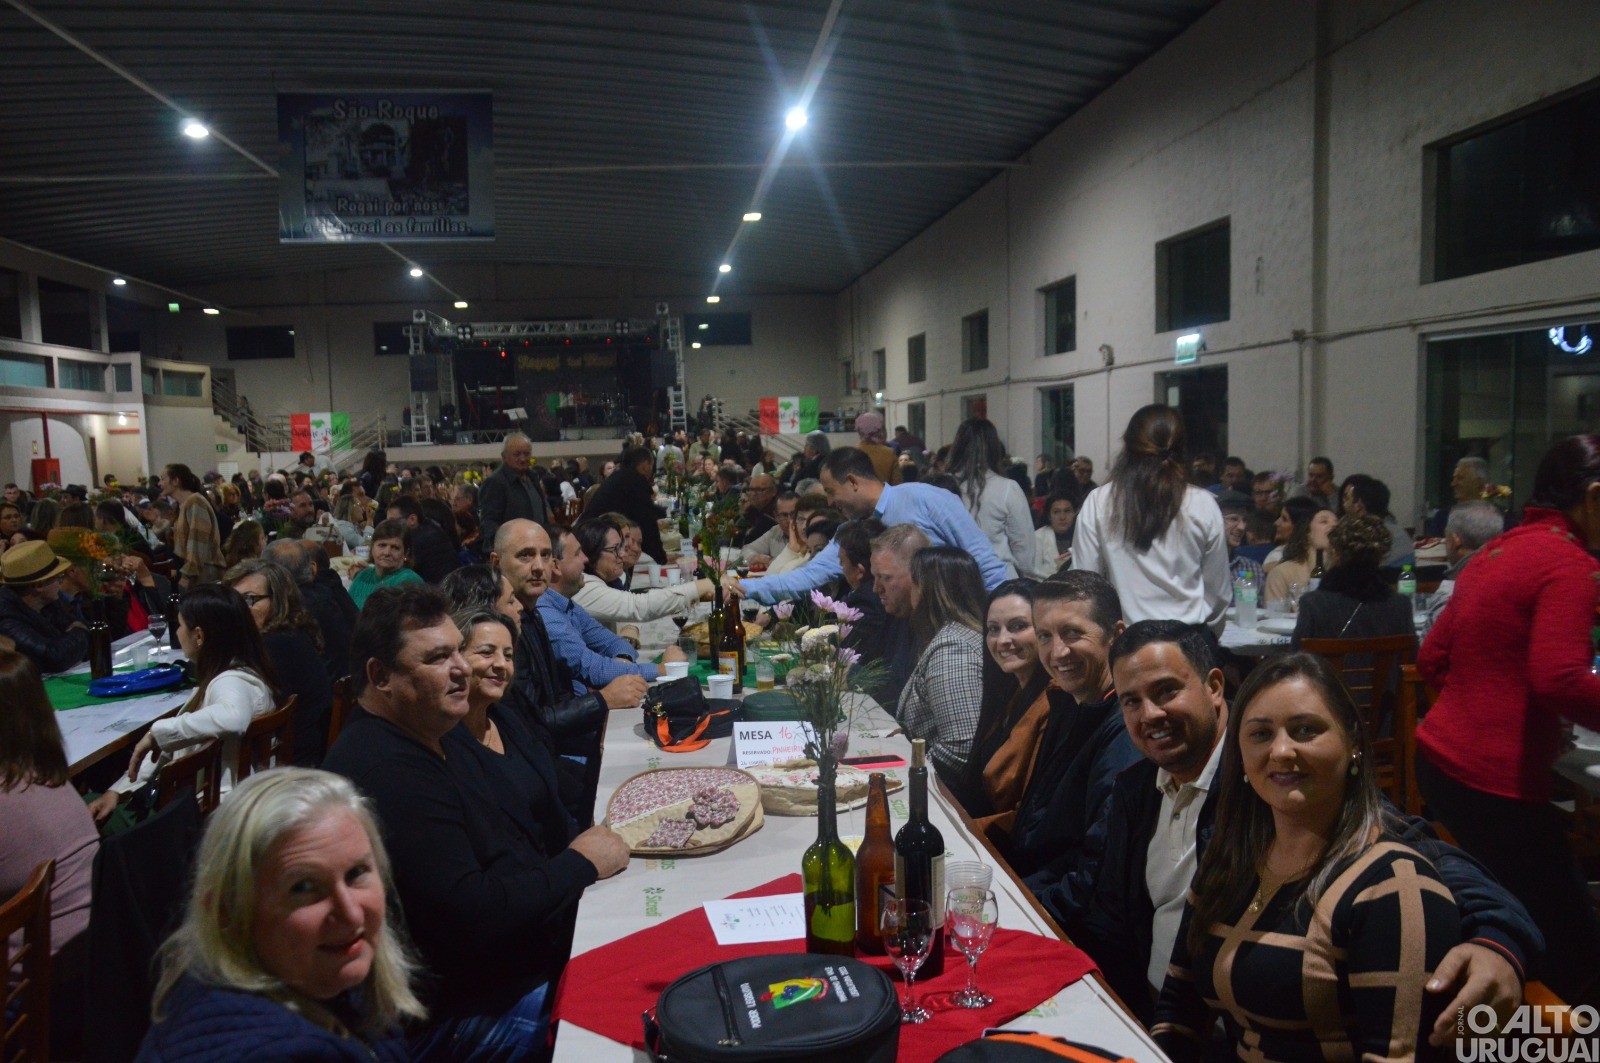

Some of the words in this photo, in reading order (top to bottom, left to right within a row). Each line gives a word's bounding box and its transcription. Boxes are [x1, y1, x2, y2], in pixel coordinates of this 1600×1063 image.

[377, 98, 440, 125] Roque
[337, 197, 379, 215] Rogai
[385, 200, 408, 216] por
[386, 222, 402, 233] as
[739, 730, 773, 741] MESA
[778, 726, 793, 740] 16
